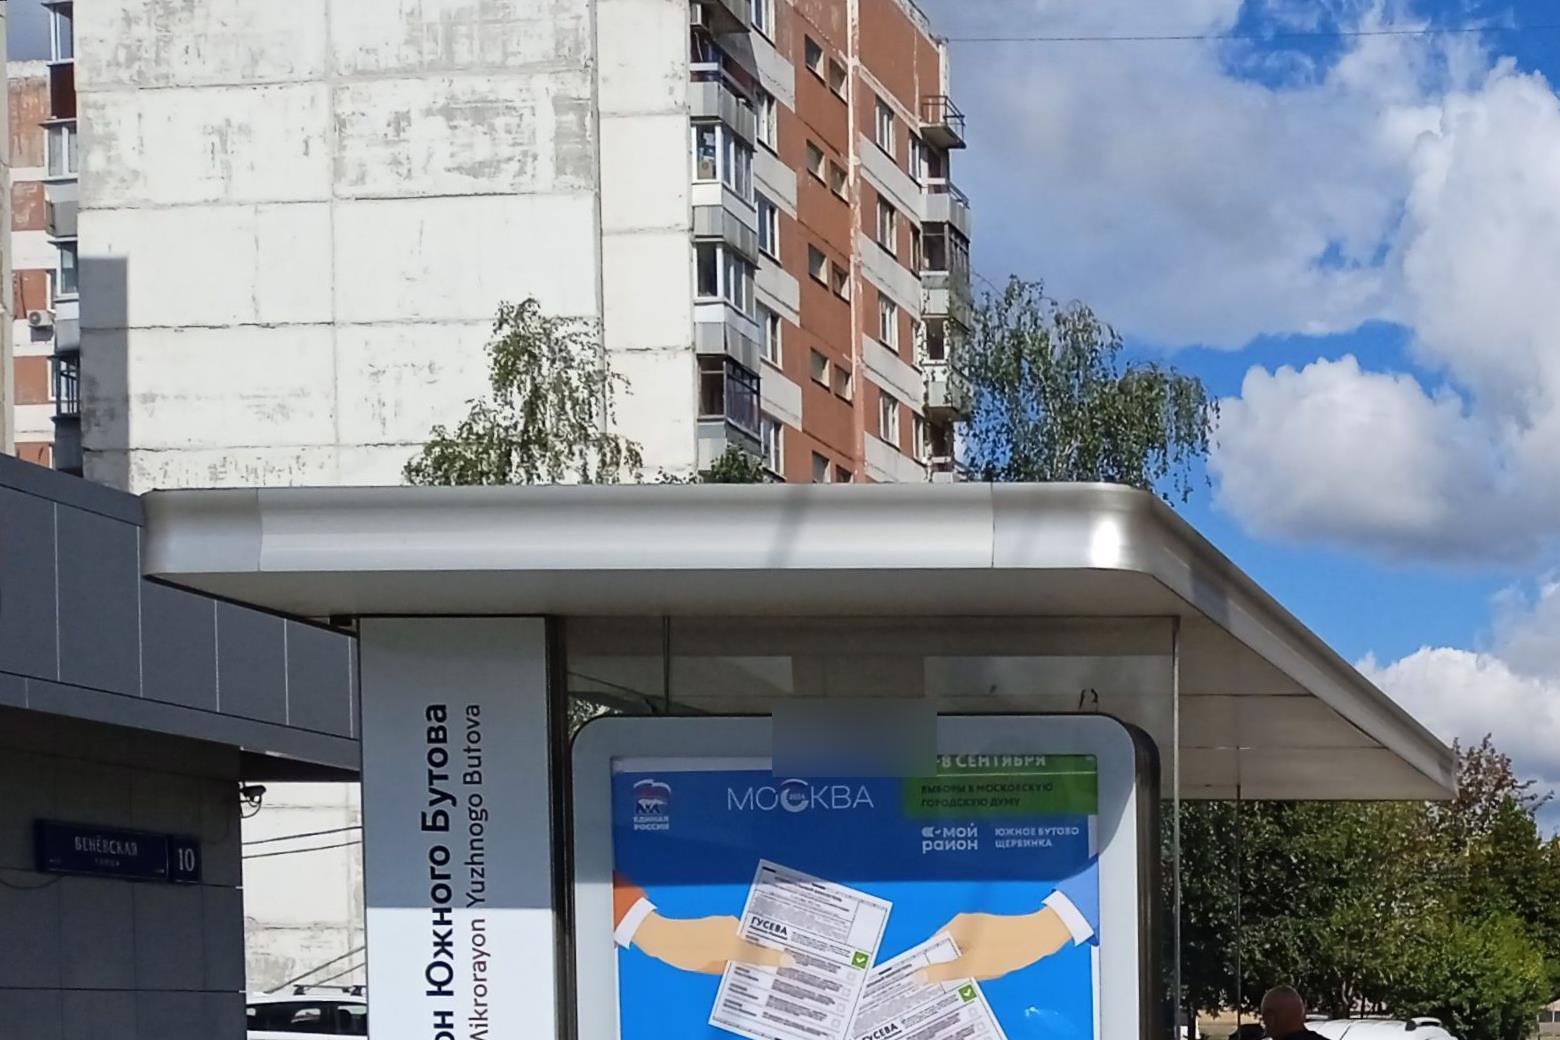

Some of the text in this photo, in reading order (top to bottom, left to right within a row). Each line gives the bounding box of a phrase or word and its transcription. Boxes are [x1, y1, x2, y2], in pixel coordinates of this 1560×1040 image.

[463, 704, 482, 785] Butova
[421, 704, 457, 833] Бутова
[727, 779, 875, 813] МОСКВА
[976, 782, 1054, 793] МОСКОВСКУЮ
[989, 797, 1021, 808] ДУМУ
[994, 826, 1080, 837] ЮЖНОЕ БУТОВО
[994, 838, 1053, 849] ЩЕРБИНКА
[178, 848, 195, 872] 10
[464, 793, 488, 908] Yuzhnogo
[425, 845, 455, 997] Южного
[750, 916, 788, 936] ГУСЕВА
